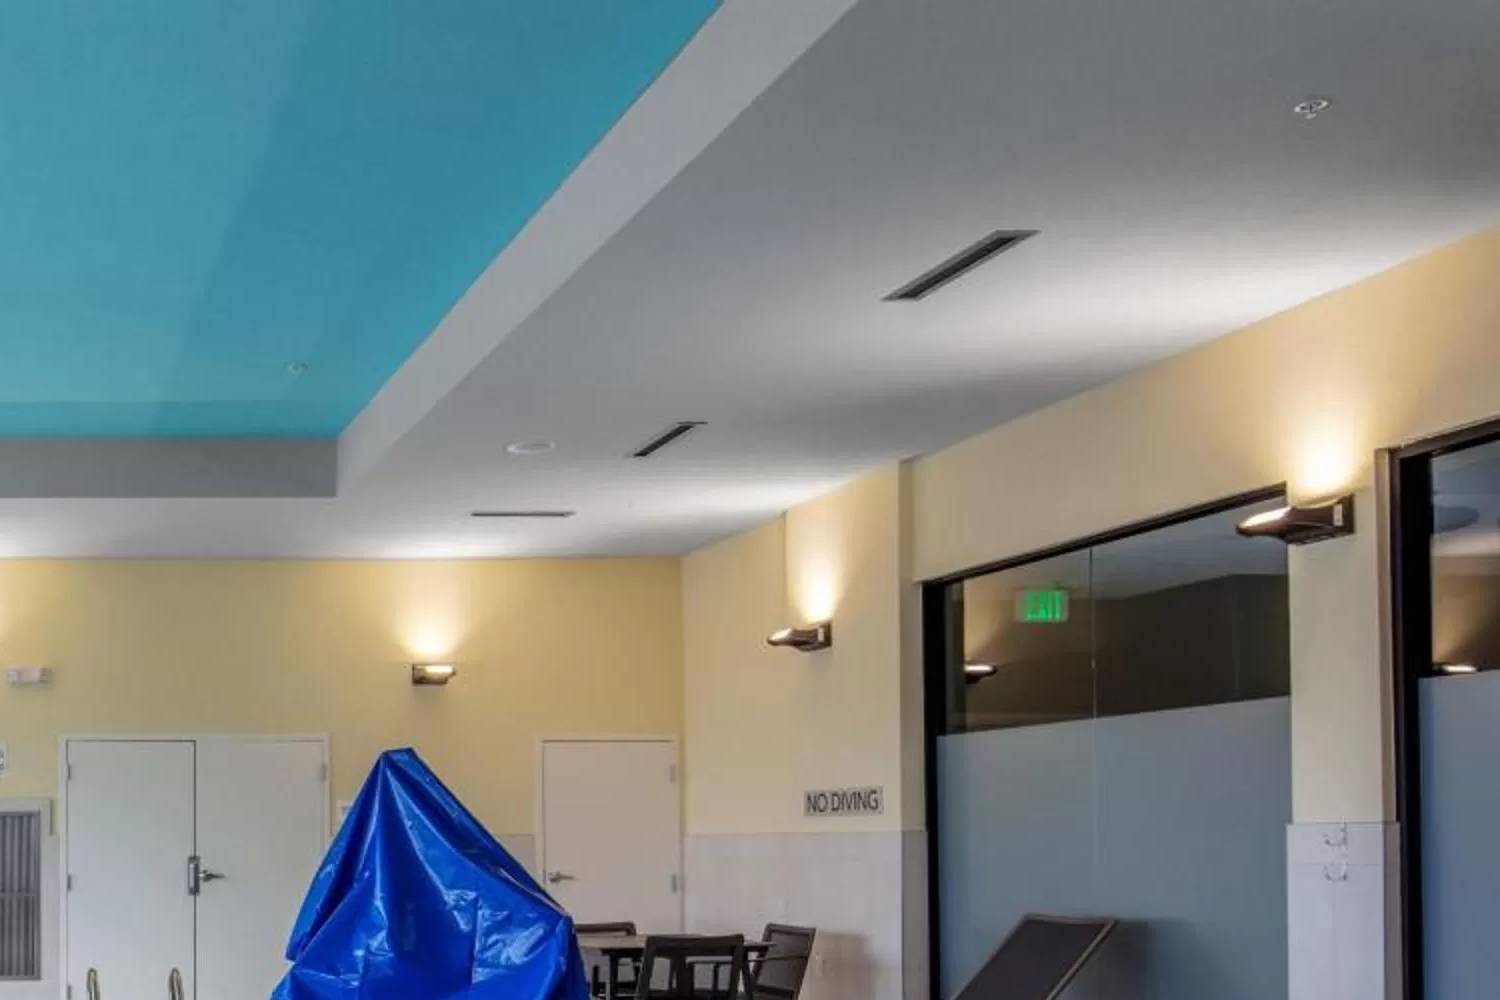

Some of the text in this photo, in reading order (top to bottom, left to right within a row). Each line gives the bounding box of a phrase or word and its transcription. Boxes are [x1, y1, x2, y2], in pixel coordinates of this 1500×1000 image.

[1026, 591, 1062, 620] EXIT
[807, 789, 879, 812] NO DIVING
